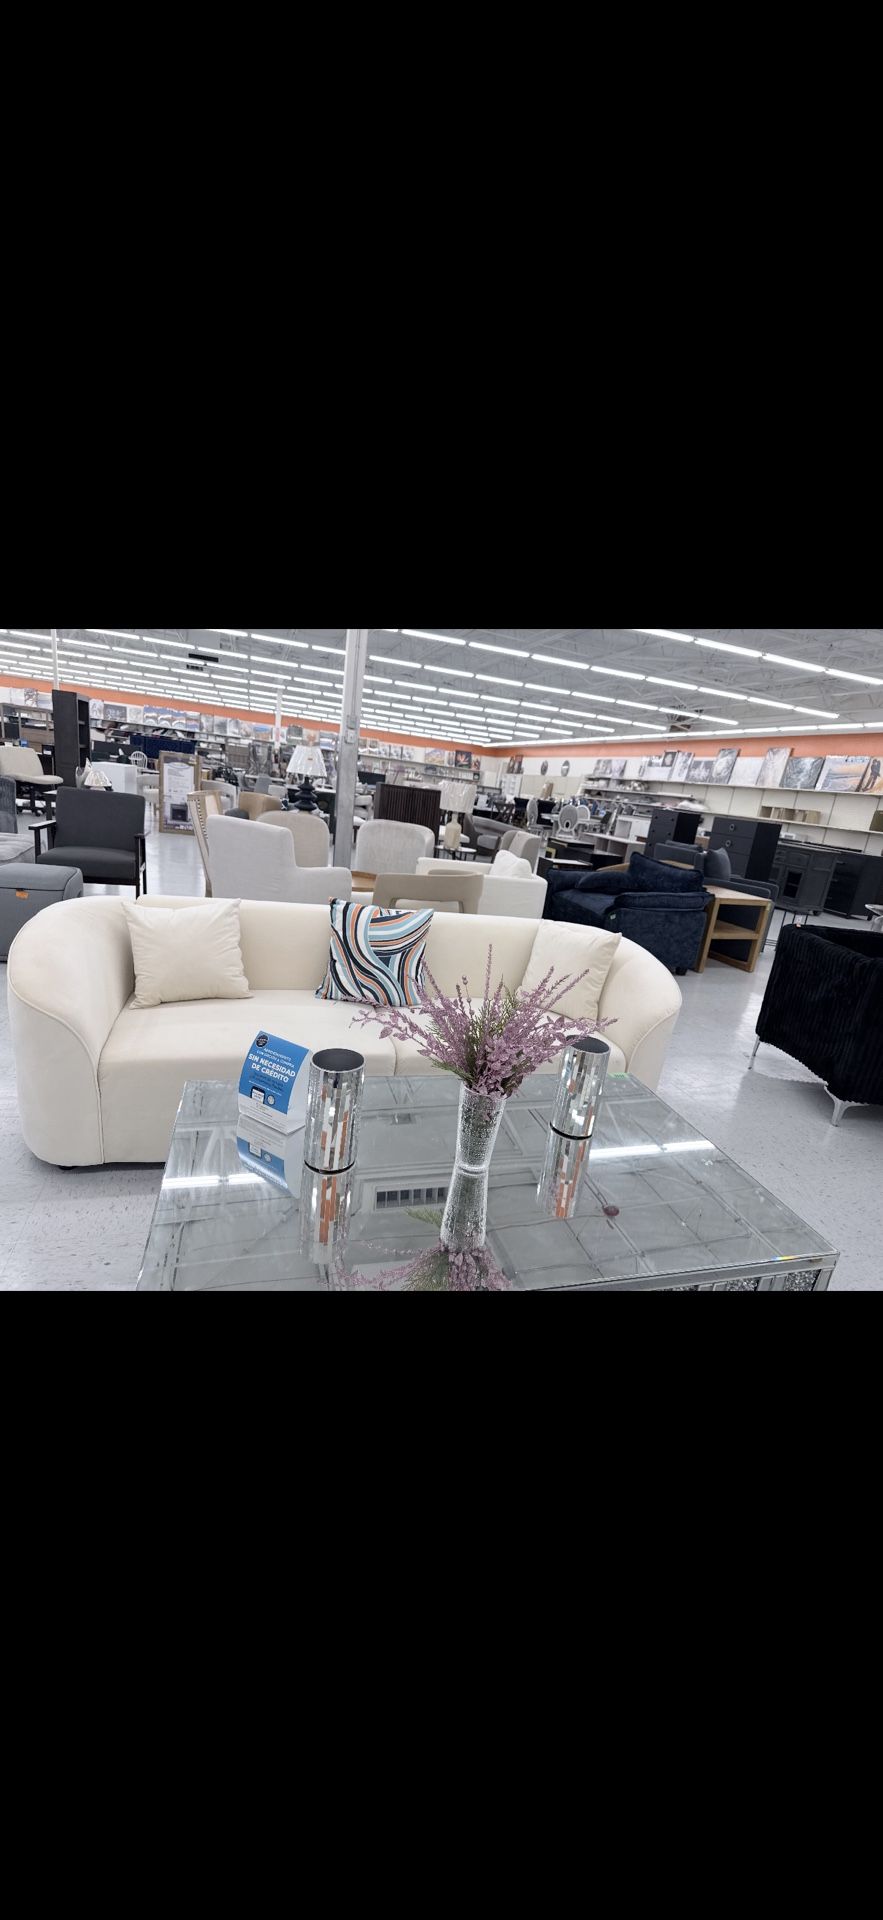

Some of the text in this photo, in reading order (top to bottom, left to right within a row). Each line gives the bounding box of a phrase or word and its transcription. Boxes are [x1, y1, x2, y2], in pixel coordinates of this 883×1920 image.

[248, 1053, 296, 1077] SIN NECESIDAD
[251, 1063, 260, 1071] DE
[261, 1066, 289, 1083] CRÉDITO
